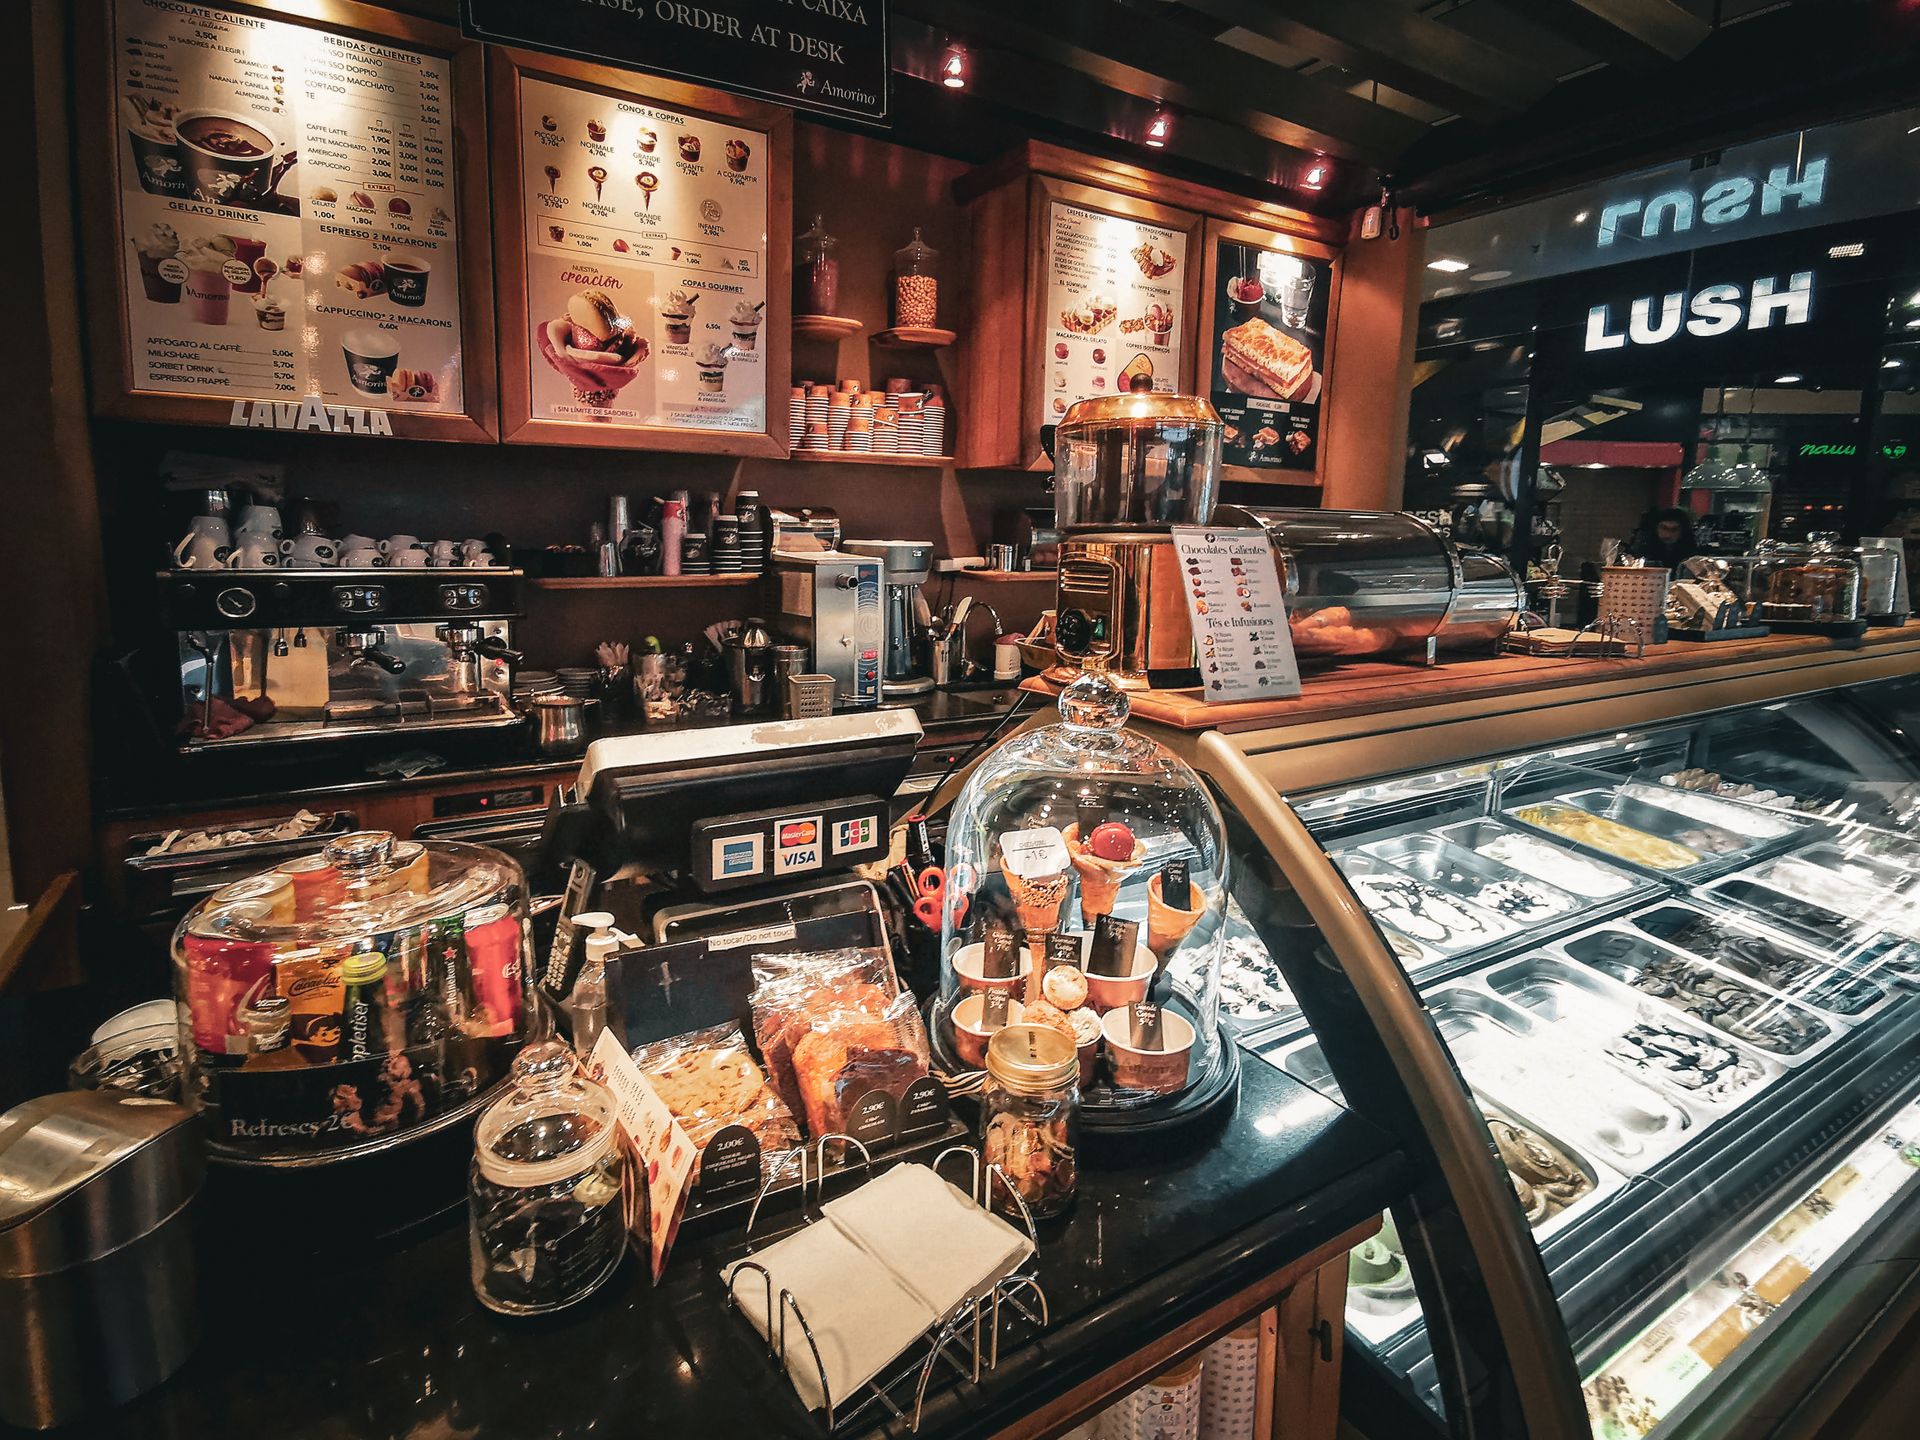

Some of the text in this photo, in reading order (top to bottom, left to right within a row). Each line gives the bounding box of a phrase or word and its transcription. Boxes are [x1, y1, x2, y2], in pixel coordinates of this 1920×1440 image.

[143, 0, 267, 29] CHOCOLATE CALIENTE
[655, 1, 742, 39] ORDER
[750, 23, 781, 48] AT
[788, 31, 845, 64] DESK
[178, 37, 209, 49] SABORES
[217, 45, 241, 55] ELEGIR
[323, 36, 423, 65] BEBIDAS CALIENTES
[233, 58, 268, 69] CARAMELO
[345, 53, 383, 67] ITALIANO
[244, 70, 269, 80] AZTECA
[346, 64, 378, 78] DOPPIO
[209, 74, 239, 85] NARANJA
[245, 81, 270, 90] CANELA
[304, 79, 347, 94] CORTADO
[347, 76, 396, 93] MACCHIATO
[235, 90, 270, 101] ALMENDRA
[820, 79, 876, 105] Amorino
[251, 103, 271, 112] COCO
[617, 103, 685, 125] CONOS & COPPAS
[328, 127, 348, 137] LATTE
[306, 135, 327, 145] LATTE
[328, 139, 367, 152] MACCHIATO
[307, 147, 348, 160] AMERICANO
[534, 130, 566, 144] PICCOLA
[580, 140, 615, 154] NORMALE
[633, 152, 661, 164] GRANDE
[676, 161, 705, 174] GIGANTE
[723, 171, 758, 183] COMPARTIR
[308, 159, 351, 172] CAPPUCCINO
[168, 201, 260, 222] GELATO DRINKS
[311, 200, 336, 209] GELATO
[537, 192, 726, 233] PICCOLO NORMALE GRANDE INFANTIL
[320, 225, 438, 249] ESPRESSO 2 MACARONS
[572, 264, 599, 274] NUESTRA
[560, 271, 624, 289] creación
[682, 279, 744, 293] COPAS GOURMET
[1585, 271, 1812, 352] LUSH
[398, 315, 453, 328] MACARONS
[147, 337, 199, 348] AFFOGATO
[200, 342, 211, 350] AL
[147, 350, 200, 361] MILKSHAKE
[148, 361, 185, 371] SORBET
[186, 365, 214, 374] DRINK
[150, 373, 196, 384] ESPRESSO
[229, 395, 393, 436] LAVAZZA
[570, 406, 592, 415] LÍMITE
[603, 409, 634, 418] SABORES
[1181, 544, 1267, 555] Chocolates Calientes
[1206, 616, 1274, 628] Tés e Infusiones
[781, 829, 816, 841] MasterCard
[840, 825, 869, 840] JCB
[782, 851, 816, 866] VISA
[710, 939, 722, 947] No
[723, 933, 758, 946] tocar/Do
[758, 932, 772, 941] not
